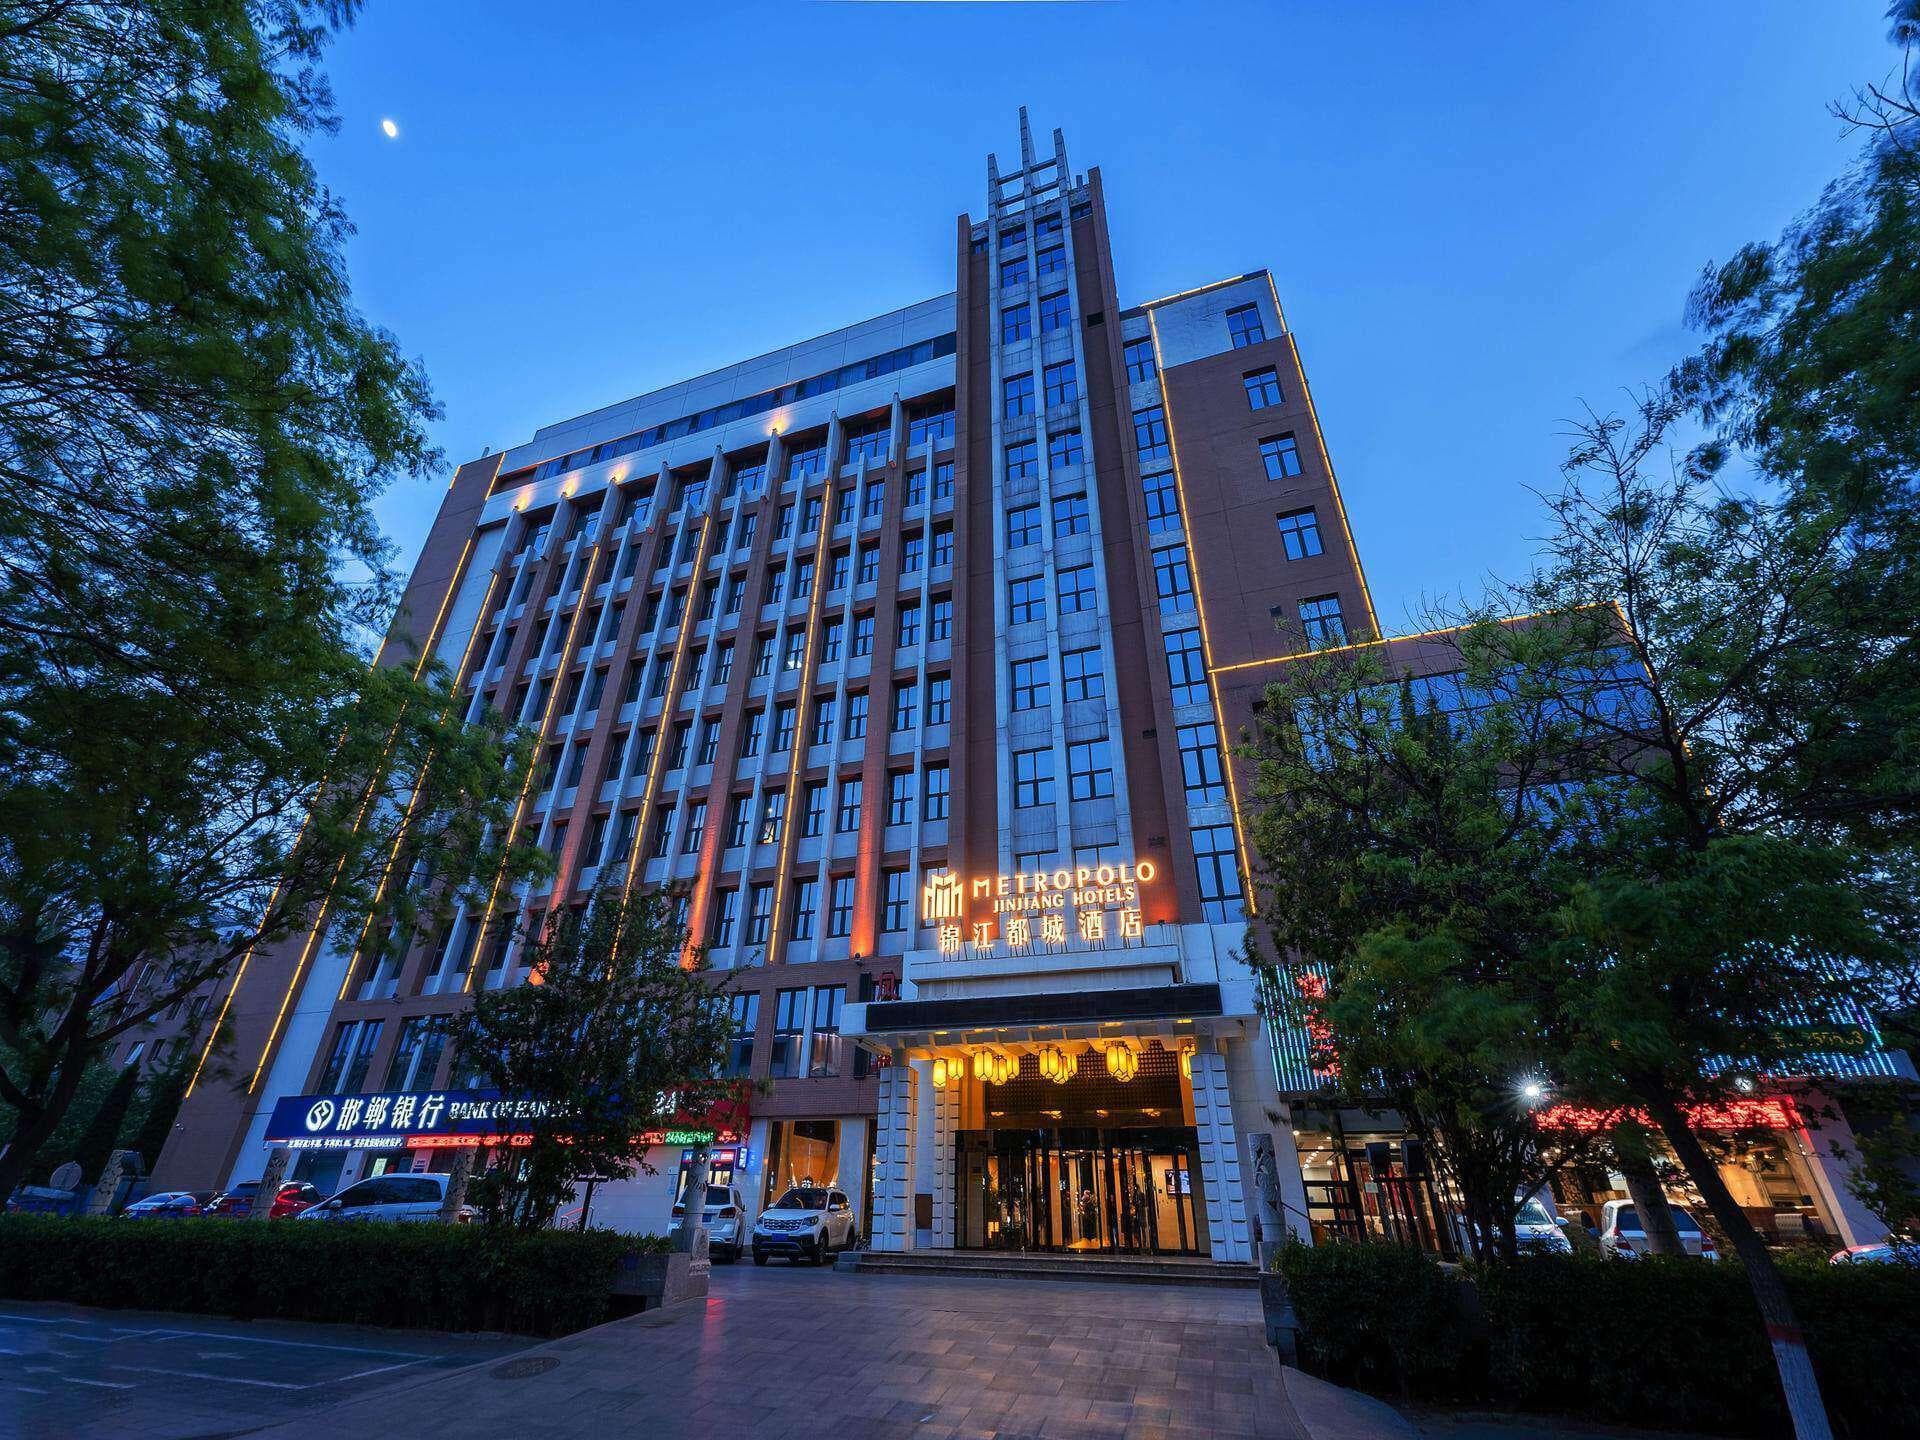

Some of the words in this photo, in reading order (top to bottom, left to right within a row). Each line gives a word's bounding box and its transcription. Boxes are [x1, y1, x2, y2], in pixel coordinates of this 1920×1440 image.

[973, 861, 1156, 898] METROPOLO
[993, 894, 1064, 914] JINJIANG
[1073, 886, 1136, 907] HOTELS
[938, 906, 1143, 953] 锦江都城酒店
[336, 1094, 445, 1131] 邯郸银行
[448, 1101, 491, 1119] BANK
